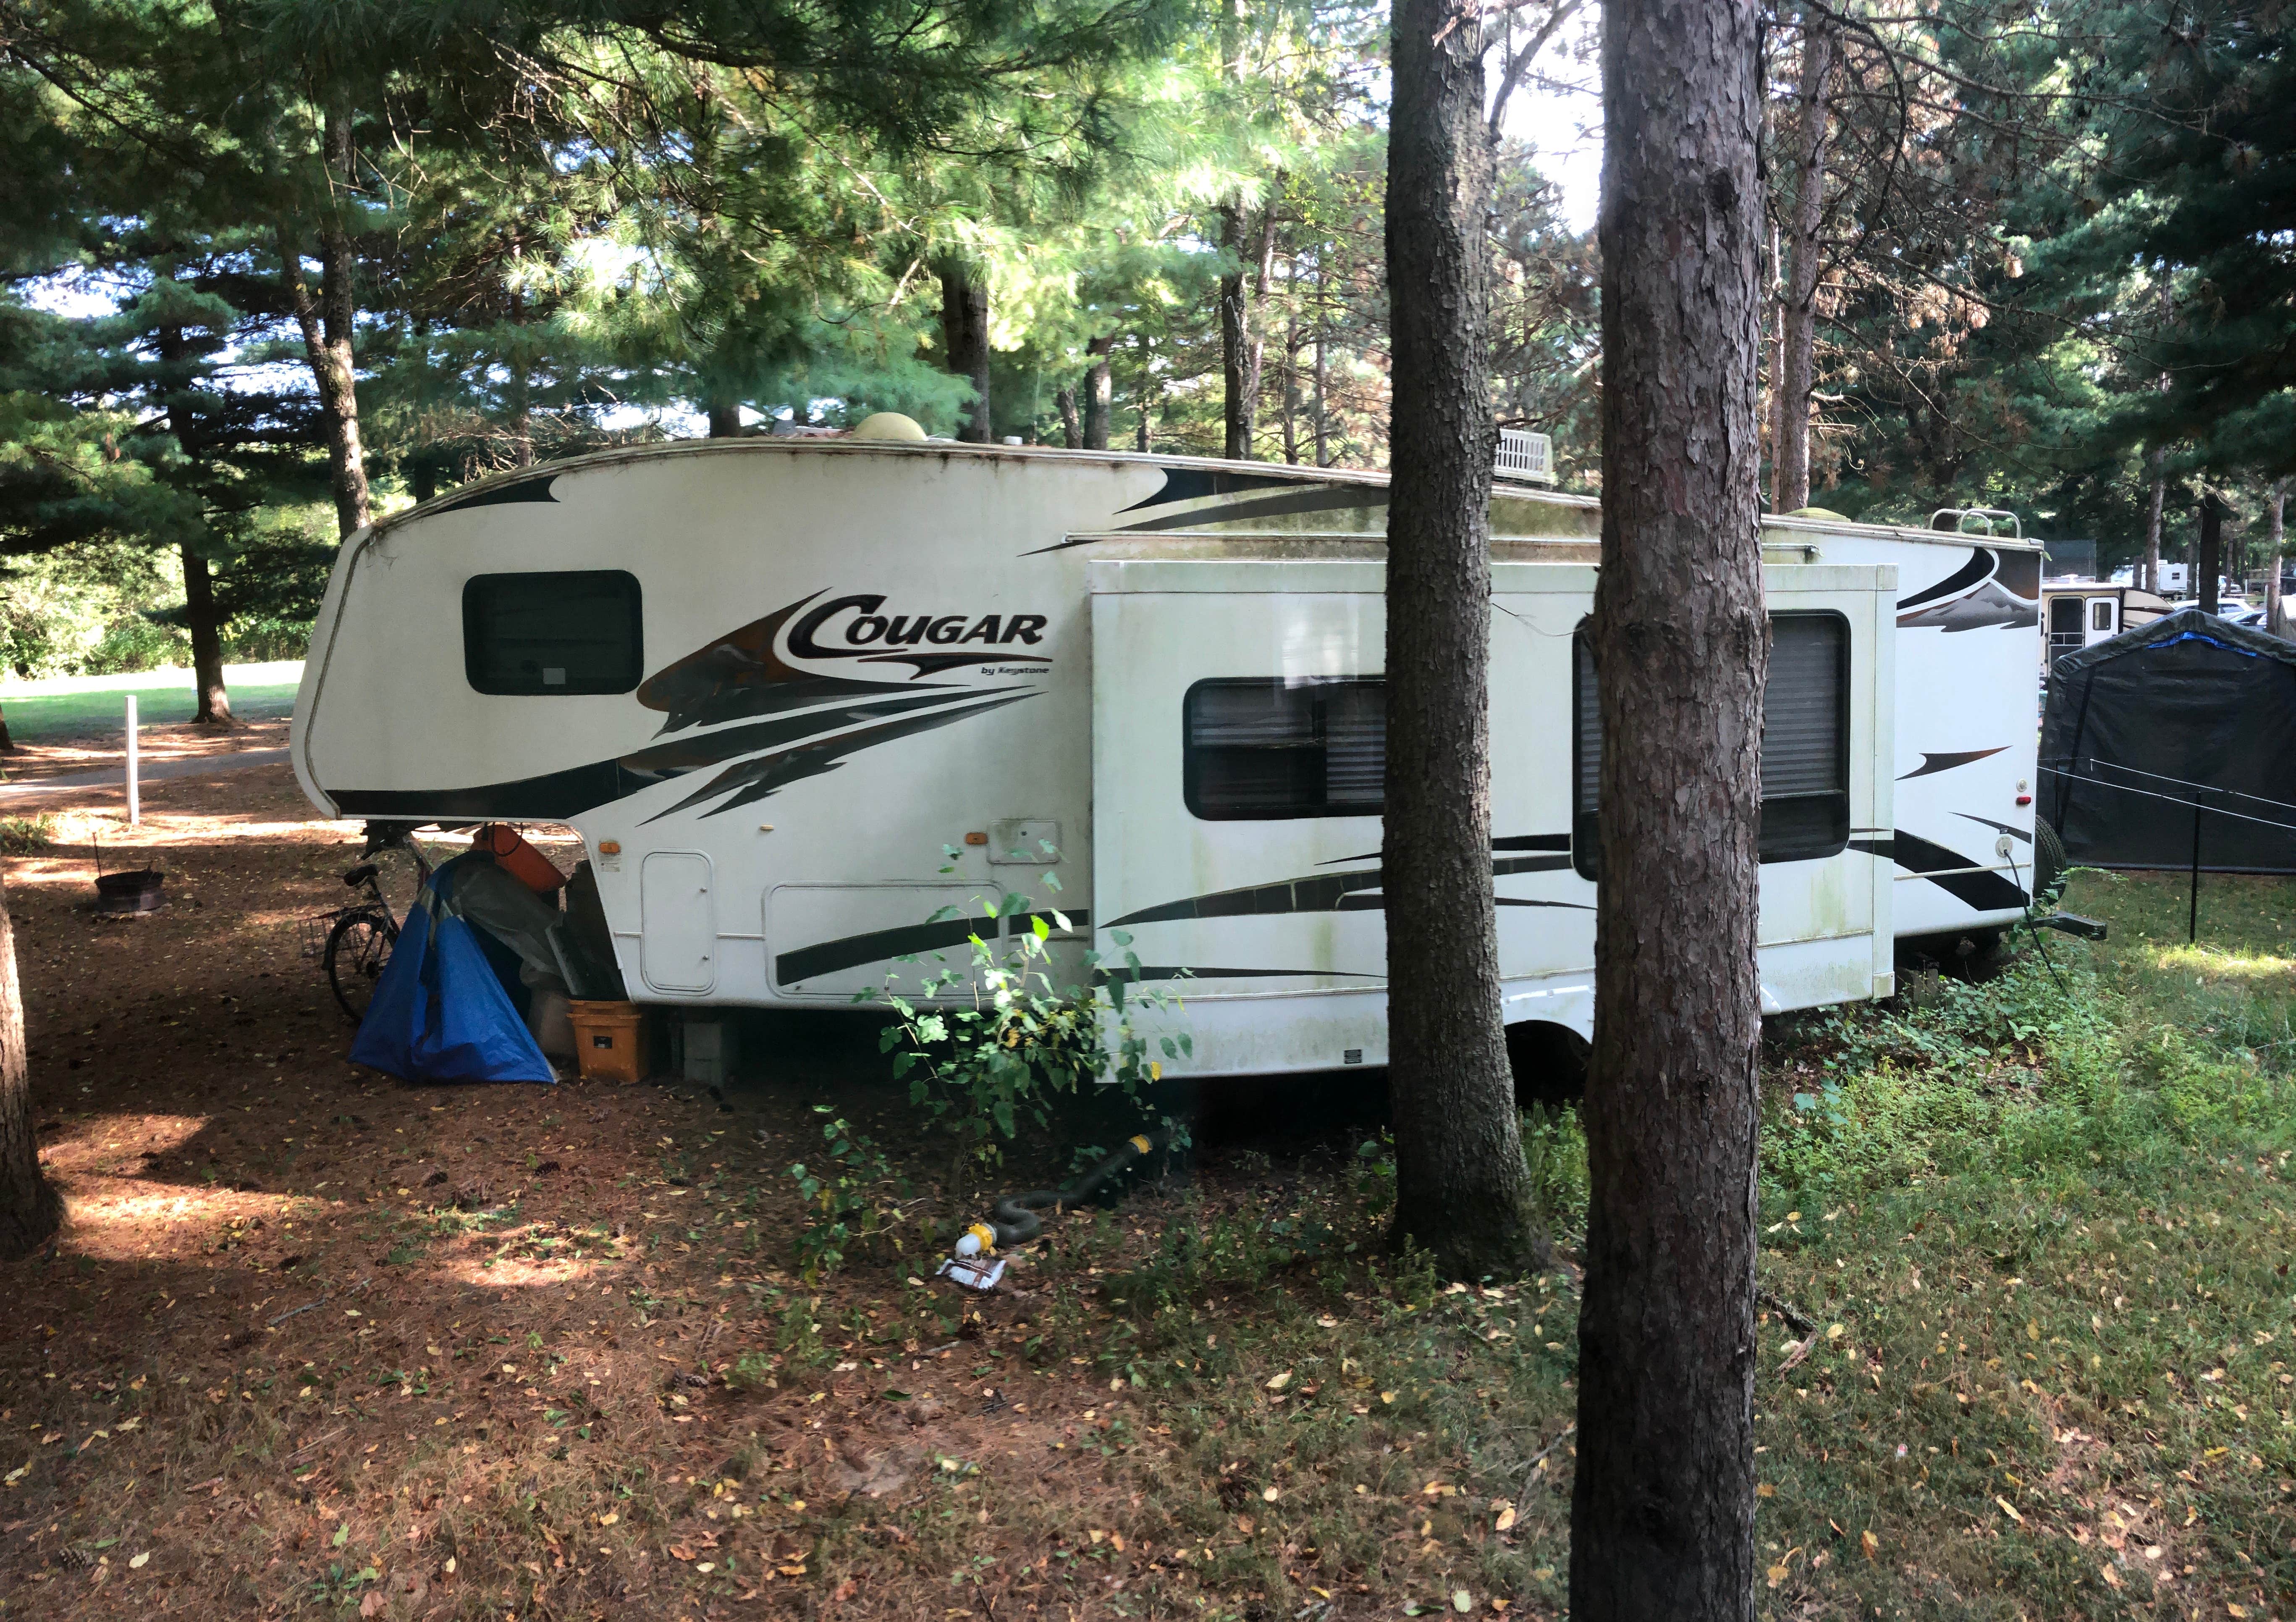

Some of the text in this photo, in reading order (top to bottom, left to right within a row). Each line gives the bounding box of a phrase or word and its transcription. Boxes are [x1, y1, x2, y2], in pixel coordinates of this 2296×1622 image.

[787, 594, 1048, 659] COUGAR
[981, 666, 1050, 675] by Keystone
